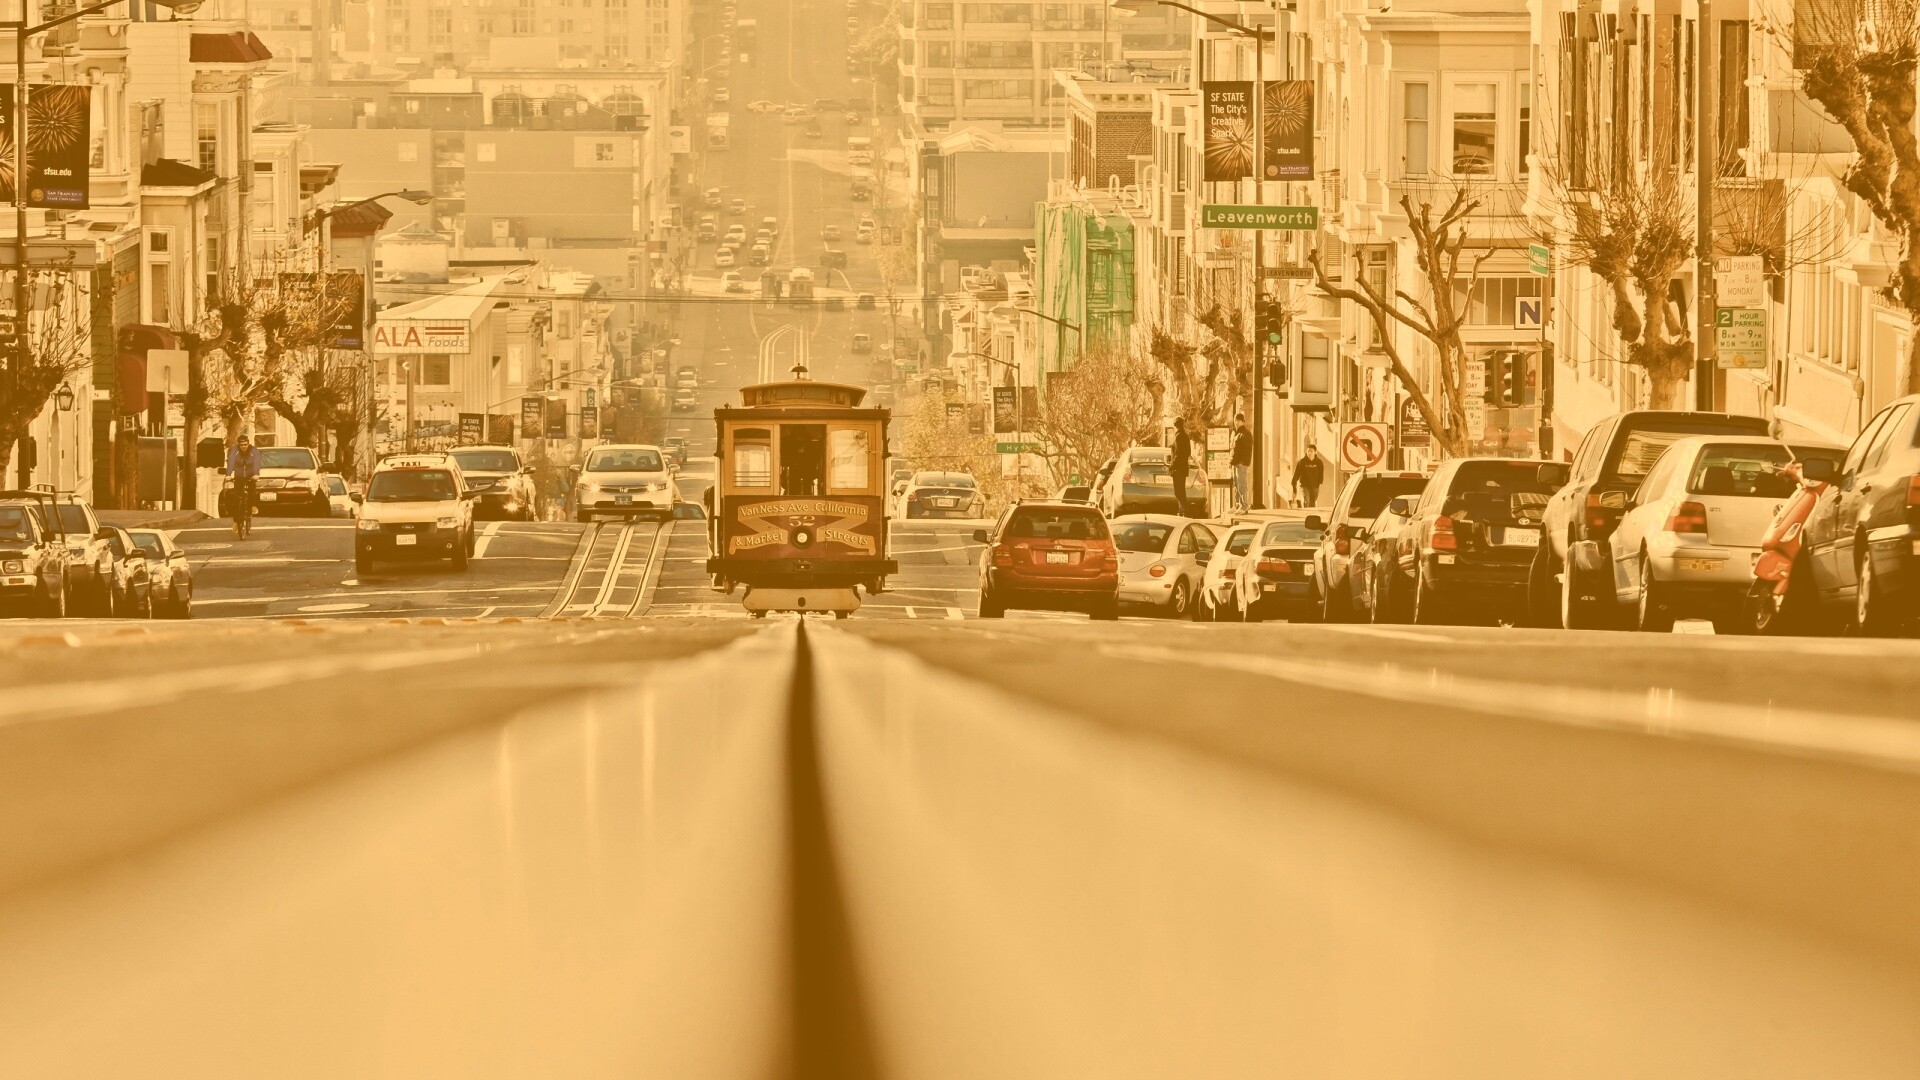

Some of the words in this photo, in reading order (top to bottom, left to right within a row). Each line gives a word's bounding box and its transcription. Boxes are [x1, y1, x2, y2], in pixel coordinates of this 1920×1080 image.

[1211, 92, 1220, 102] SF
[1223, 92, 1244, 102] STATE
[1211, 104, 1225, 114] The
[1226, 104, 1247, 115] City's
[1211, 116, 1244, 126] Creative
[1211, 129, 1234, 139] Spark
[44, 167, 72, 176] sfsu.edu
[1207, 210, 1312, 224] Leavenworth
[1718, 259, 1731, 271] NO
[1733, 261, 1760, 271] PARKING
[1267, 269, 1312, 277] LEAVENWORTH
[1728, 287, 1754, 295] MONDAY
[1721, 312, 1730, 324] 2
[1739, 312, 1759, 320] HOUR
[428, 336, 464, 347] Foods
[1466, 364, 1483, 372] ARKING
[741, 506, 759, 516] Van
[760, 504, 785, 514] Ness
[815, 502, 866, 516] California
[735, 536, 743, 546] &
[746, 532, 783, 547] Market
[825, 529, 869, 545] Streets
